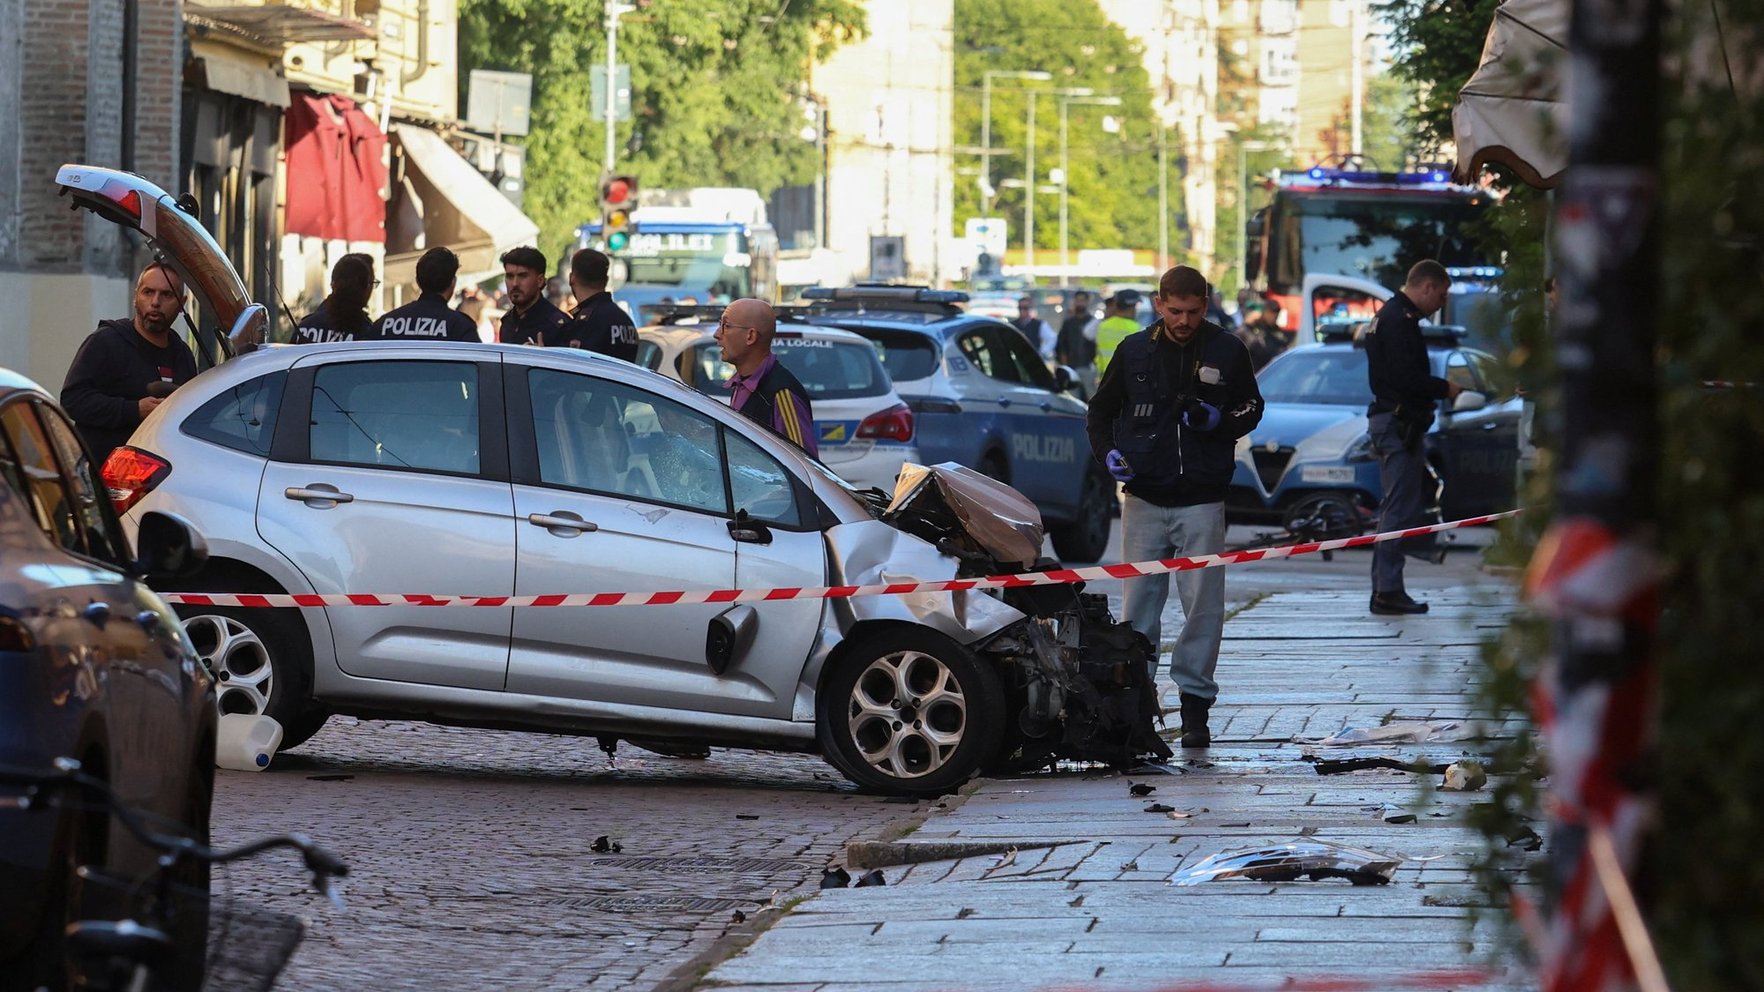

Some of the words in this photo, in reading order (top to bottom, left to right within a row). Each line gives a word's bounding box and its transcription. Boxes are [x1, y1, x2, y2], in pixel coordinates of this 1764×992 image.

[381, 317, 448, 337] POLIZIA
[787, 339, 833, 348] LOCALE
[1012, 432, 1075, 463] POLIZIA
